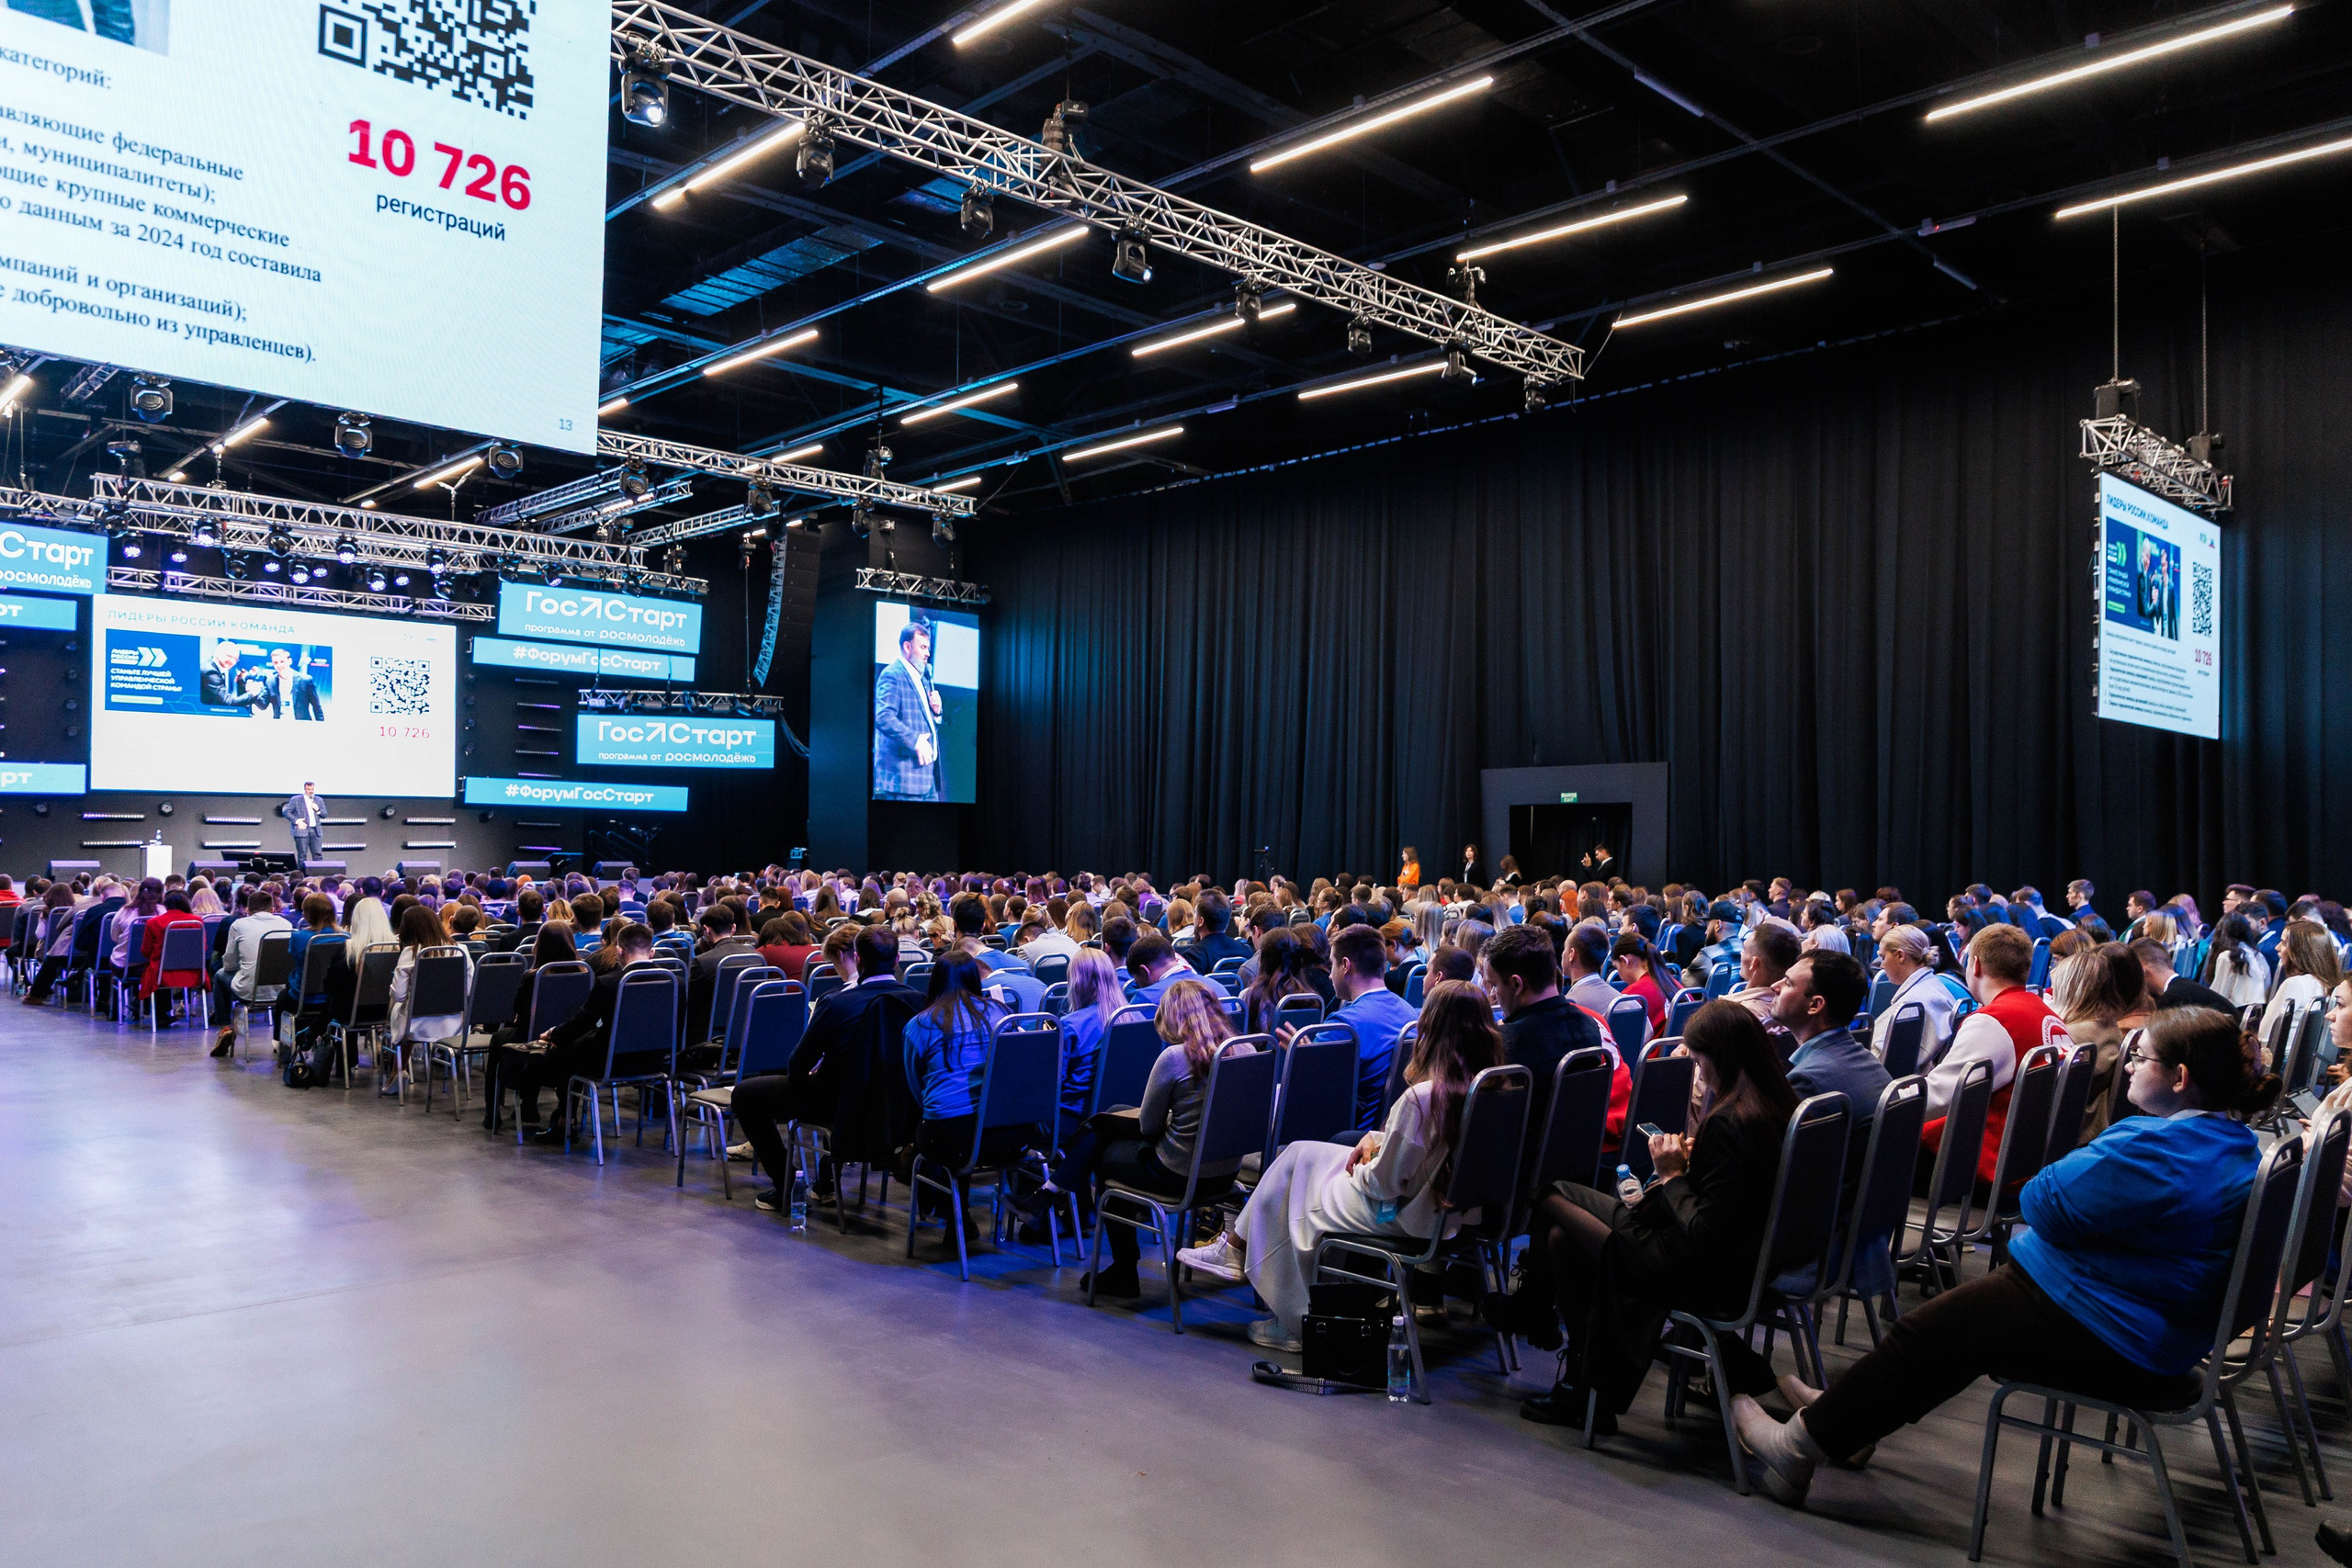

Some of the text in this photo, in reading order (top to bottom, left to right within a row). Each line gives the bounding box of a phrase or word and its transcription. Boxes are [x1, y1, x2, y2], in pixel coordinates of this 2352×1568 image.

[0, 105, 243, 181] вляющие федеральные
[348, 118, 531, 210] 10 726
[23, 141, 216, 204] муниципалитеты);
[0, 166, 289, 247] щие крупные коммерческие
[376, 194, 505, 242] регистраций
[18, 200, 103, 231] данным
[110, 221, 130, 238] за
[137, 223, 185, 250] 2024
[190, 239, 223, 261] год
[228, 250, 322, 283] составила
[86, 274, 99, 288] и
[106, 278, 247, 322] организаций);
[12, 288, 151, 327] добровольно
[156, 318, 178, 333] из
[184, 322, 317, 364] управленцев).
[559, 418, 573, 432] 13
[107, 610, 295, 634] ЛИДЕРЫ РОССИИ КОМАНДА
[525, 624, 581, 637] программа
[583, 629, 596, 637] от
[512, 646, 662, 672] #ФорумГосСтарт
[379, 726, 430, 739] 10 726
[598, 751, 648, 761] программа
[650, 753, 662, 761] от
[505, 784, 654, 805] #ФорумГосСтарт
